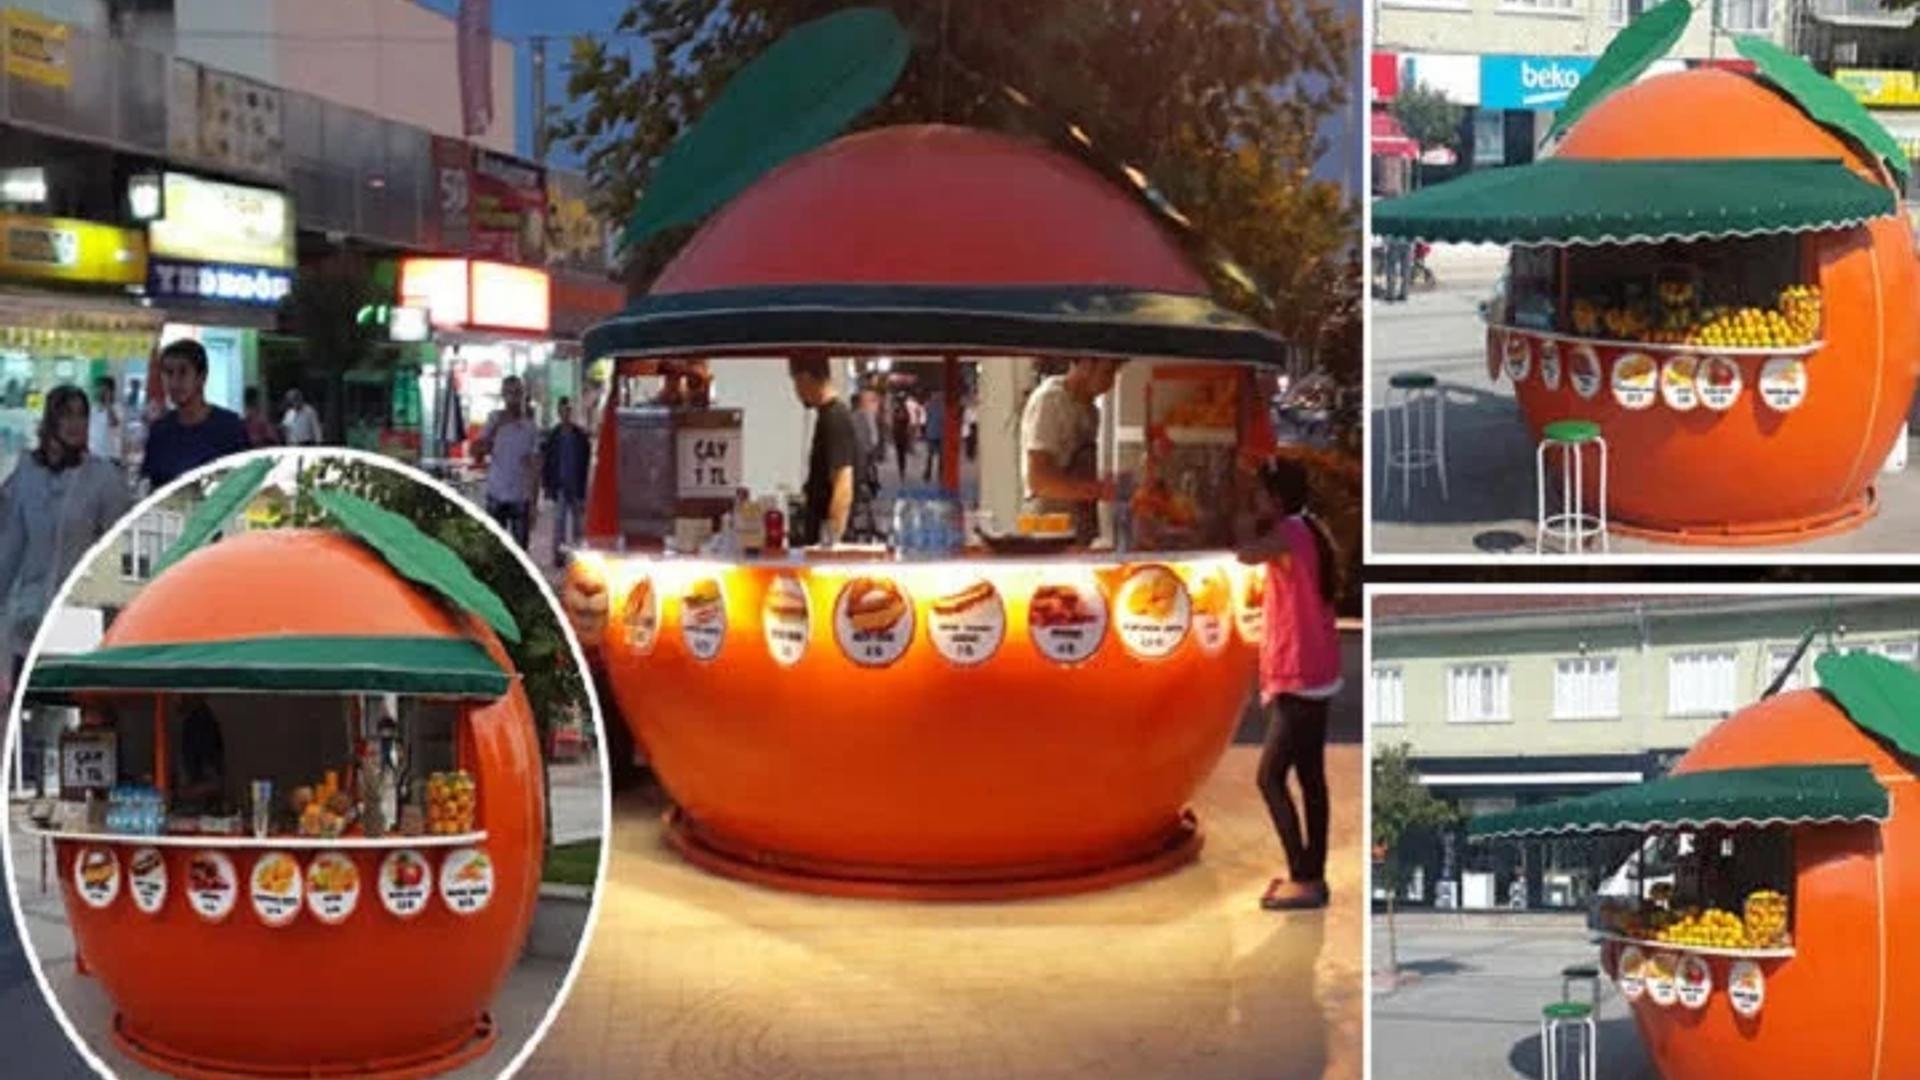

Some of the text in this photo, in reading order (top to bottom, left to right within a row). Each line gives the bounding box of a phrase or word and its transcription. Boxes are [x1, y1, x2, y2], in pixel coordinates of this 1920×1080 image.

[1522, 60, 1580, 88] beko
[694, 439, 728, 461] ÇAY
[695, 467, 728, 486] 1 TL
